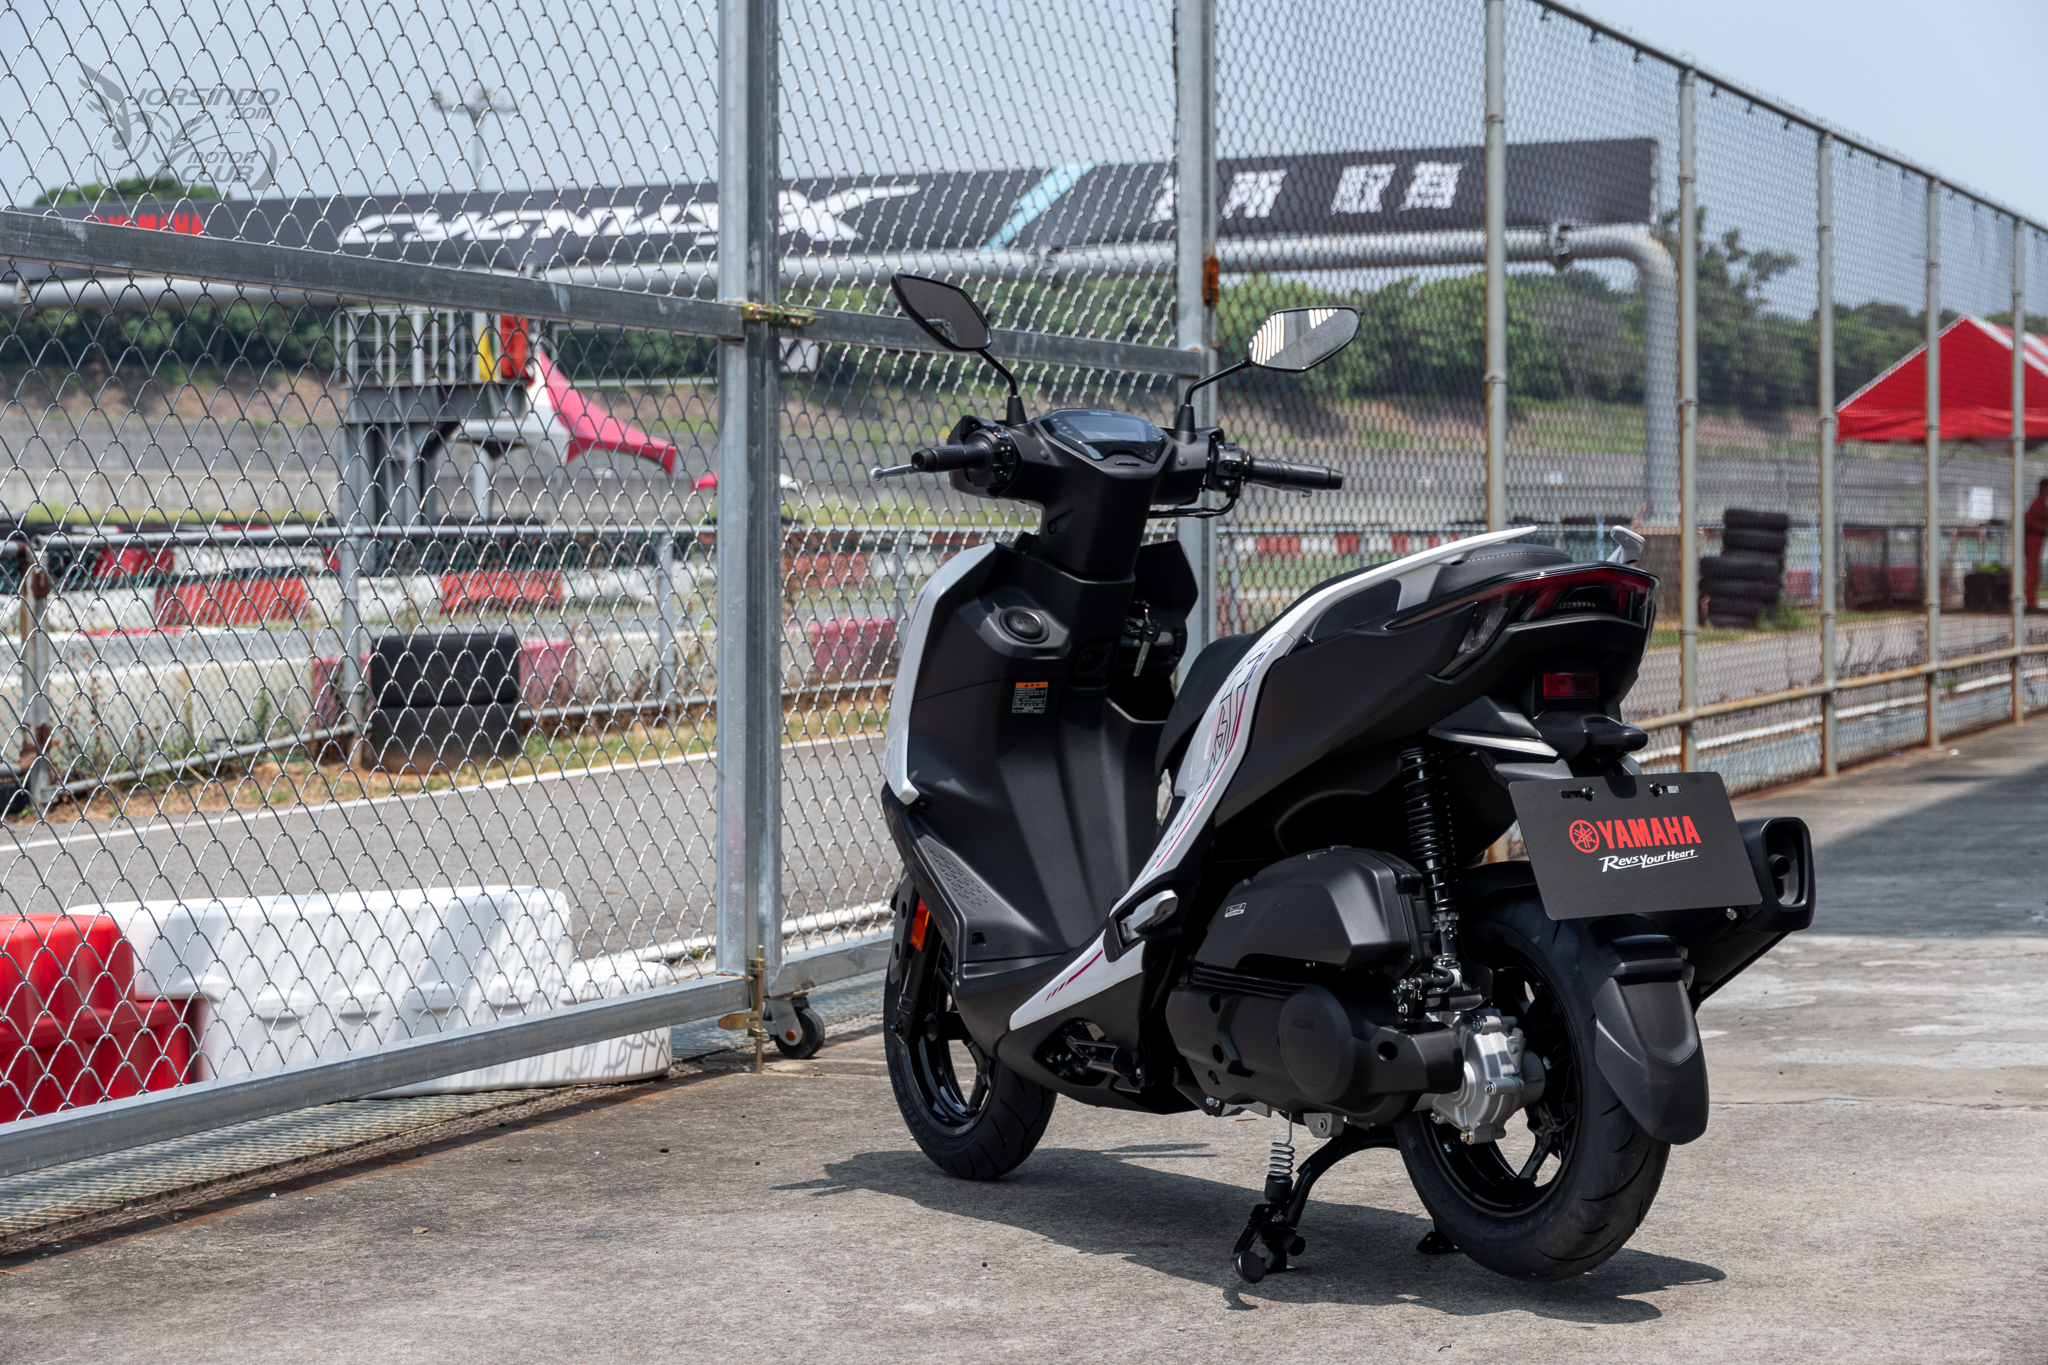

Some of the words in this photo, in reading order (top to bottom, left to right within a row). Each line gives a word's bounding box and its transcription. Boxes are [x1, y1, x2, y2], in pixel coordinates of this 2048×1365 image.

[1596, 816, 1702, 849] YAMAHA
[1598, 854, 1641, 873] Revs
[1639, 852, 1667, 869] Your
[1666, 848, 1697, 861] Heart
